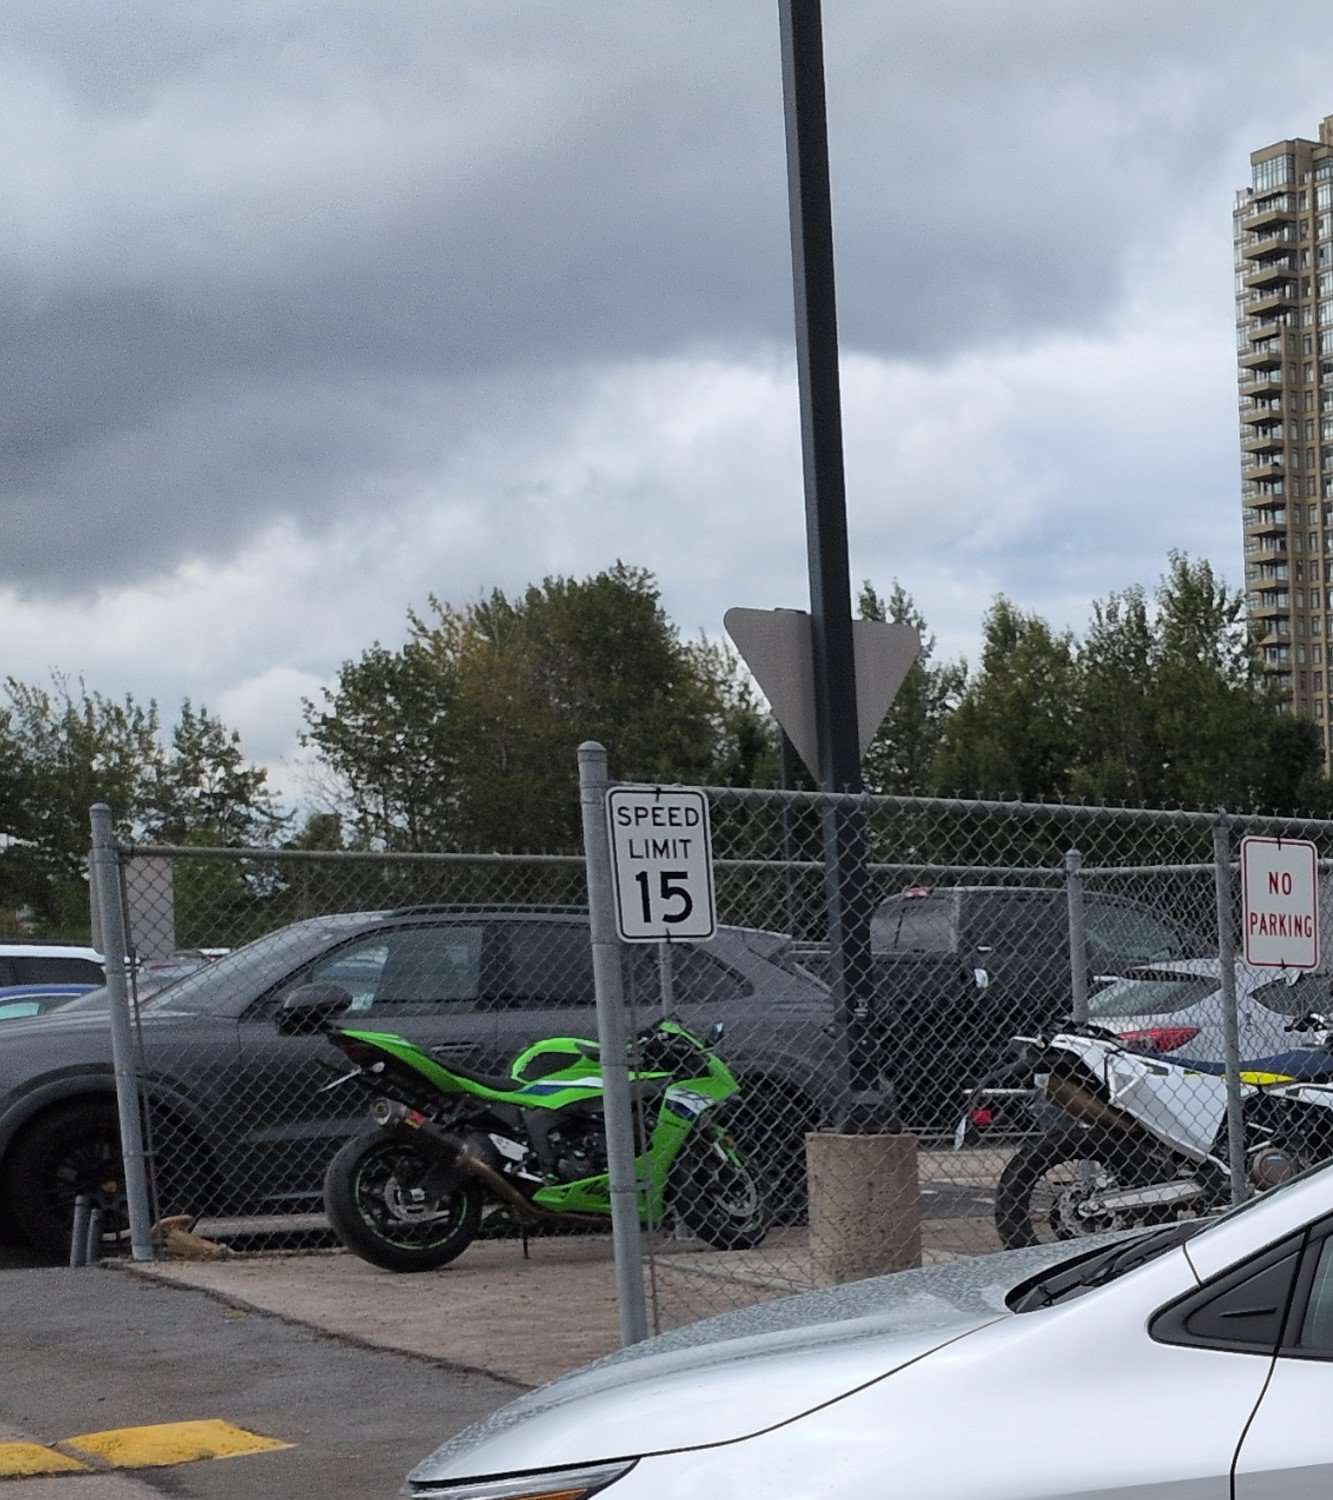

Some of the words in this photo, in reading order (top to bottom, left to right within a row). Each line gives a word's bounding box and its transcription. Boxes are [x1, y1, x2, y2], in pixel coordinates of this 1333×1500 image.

[616, 806, 700, 827] SPEED
[628, 838, 692, 859] LIMIT
[1268, 871, 1292, 895] NO
[635, 871, 693, 923] 15
[1249, 912, 1313, 937] PARKING
